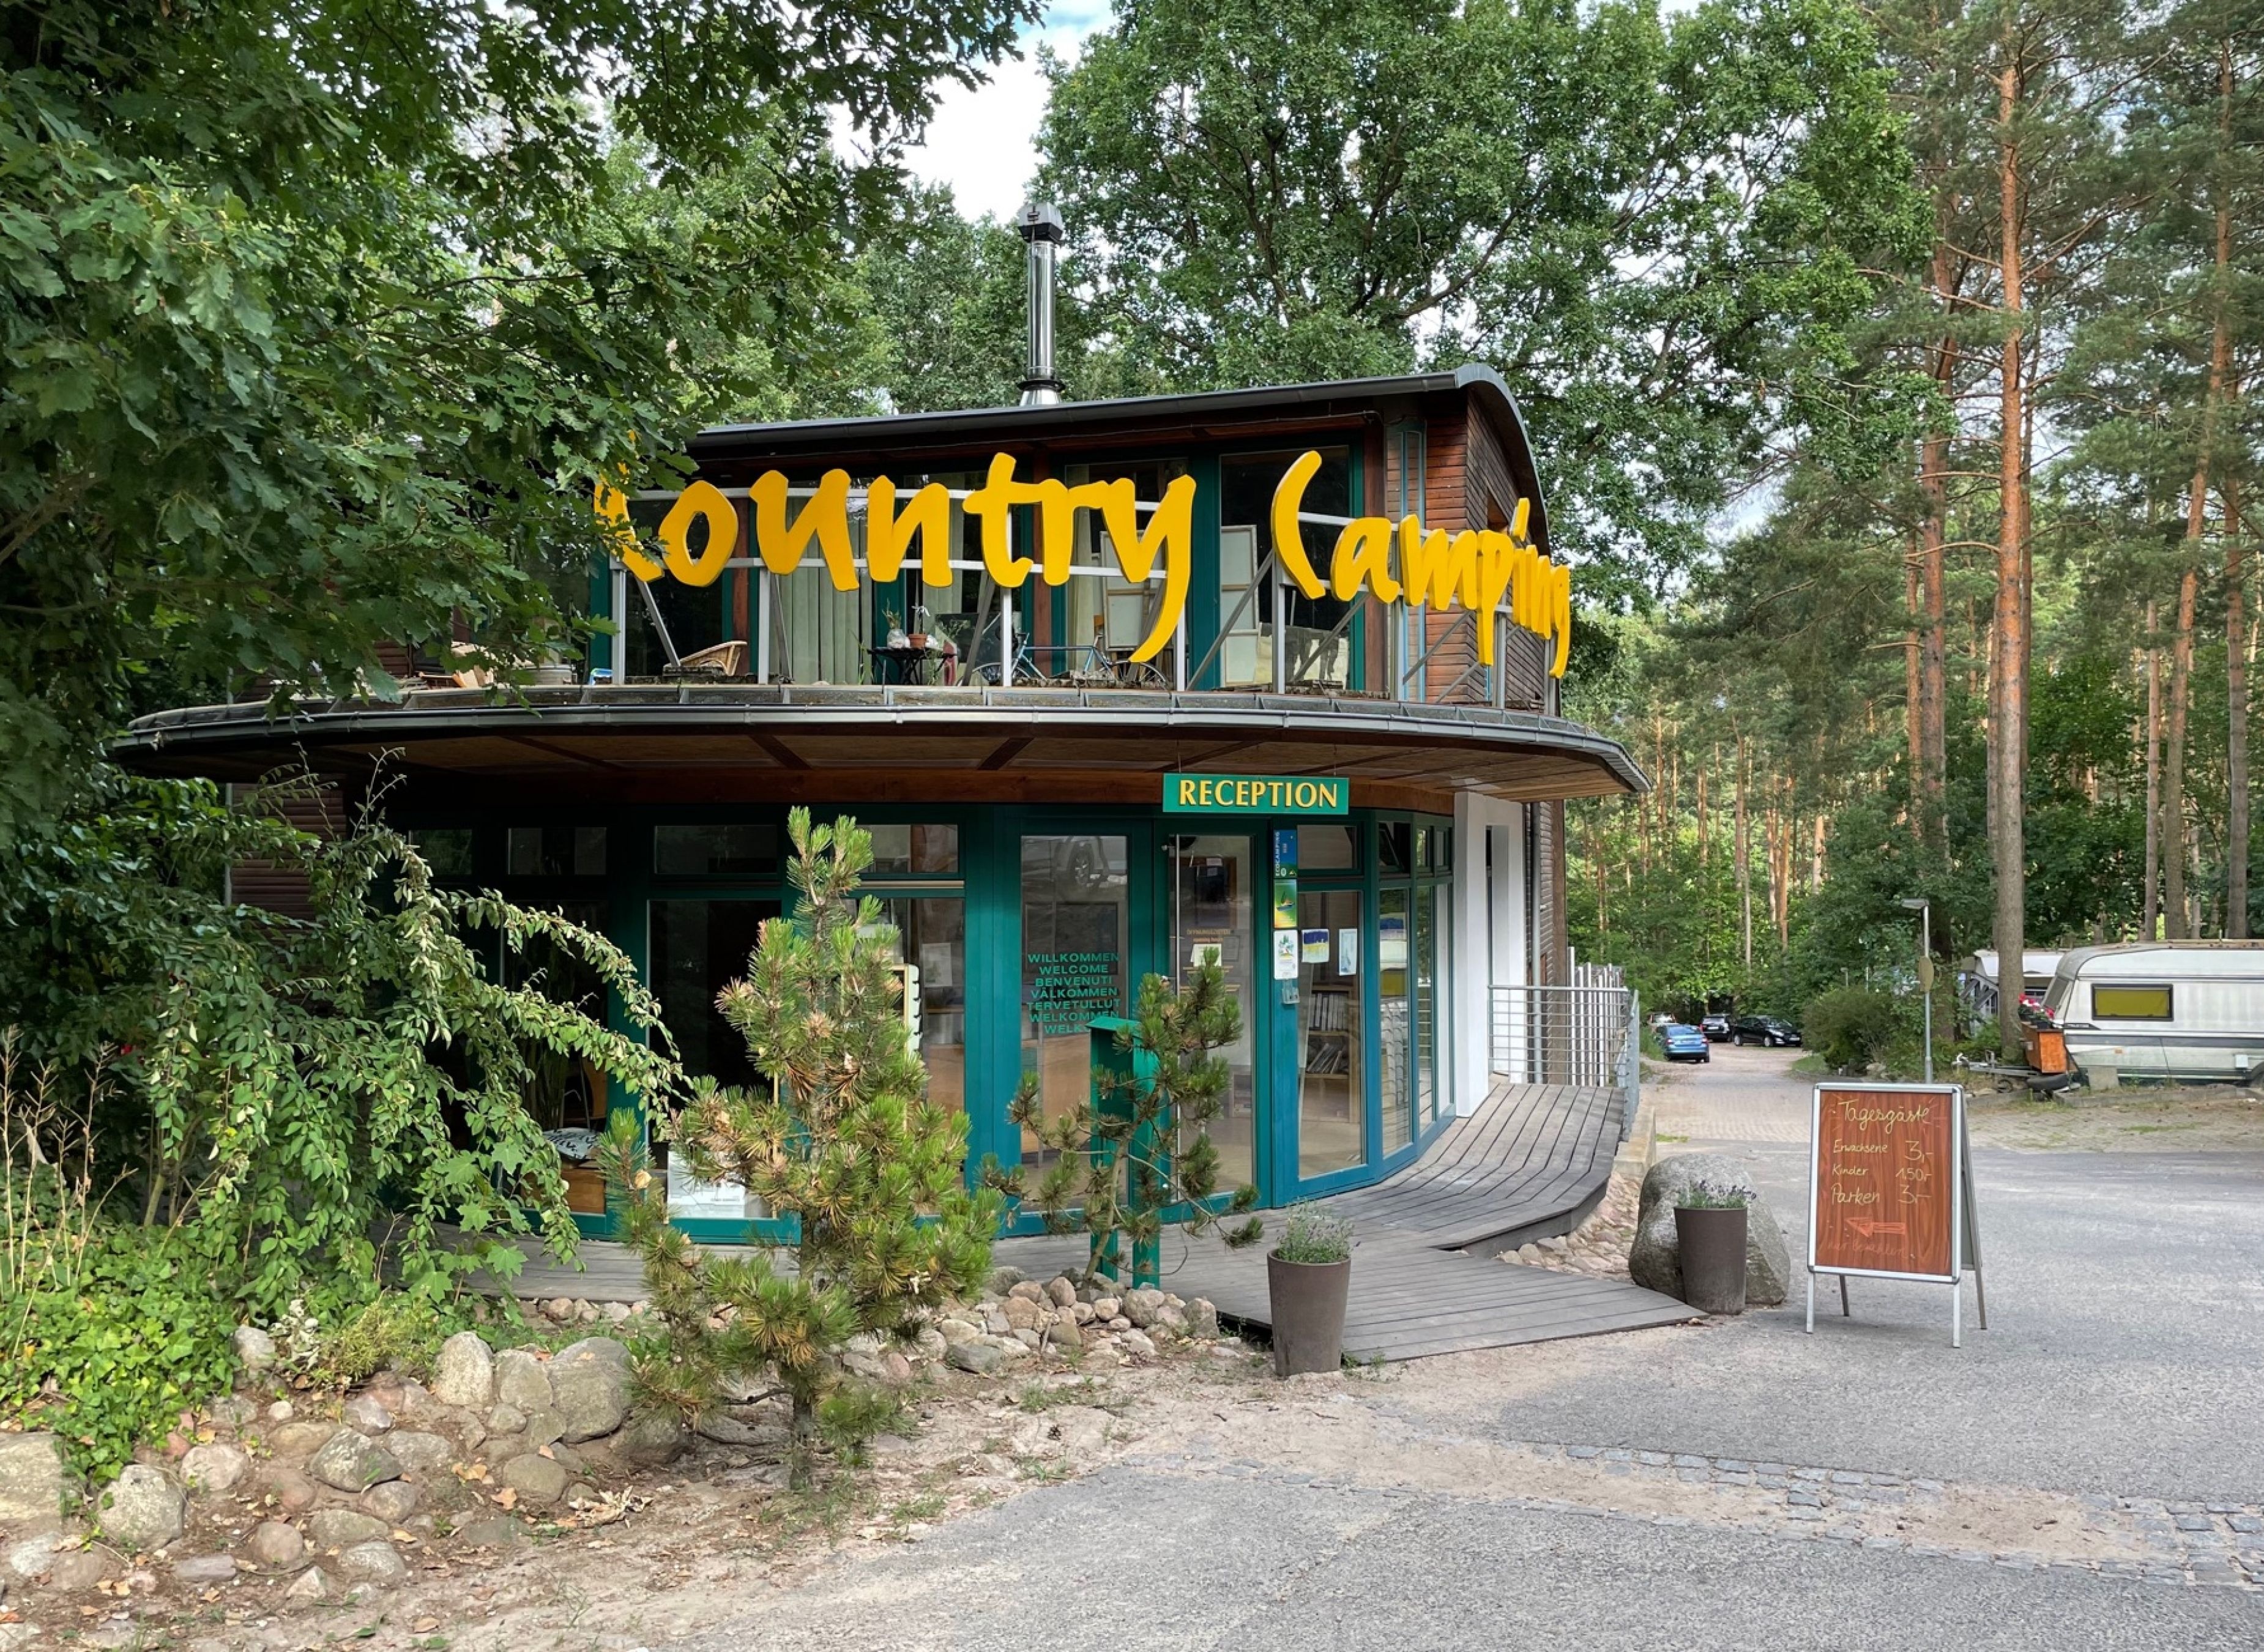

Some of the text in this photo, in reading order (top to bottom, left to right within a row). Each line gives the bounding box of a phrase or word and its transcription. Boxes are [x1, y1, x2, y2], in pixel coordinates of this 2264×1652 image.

[1272, 450, 1571, 679] Camping
[1179, 779, 1338, 808] RECEPTION
[1027, 953, 1119, 962] WILLKOMMEN
[1039, 964, 1109, 975] WELCOME
[1035, 975, 1112, 987] BENVENUTI
[1031, 987, 1118, 999] VÄLKOMMEN
[1027, 999, 1121, 1011] TERVETULLUT
[1838, 1099, 1929, 1134] Tagesgäste
[1833, 1139, 1888, 1153] Erwachsene
[1832, 1164, 1869, 1176] Kinder
[1831, 1183, 1880, 1205] Parken
